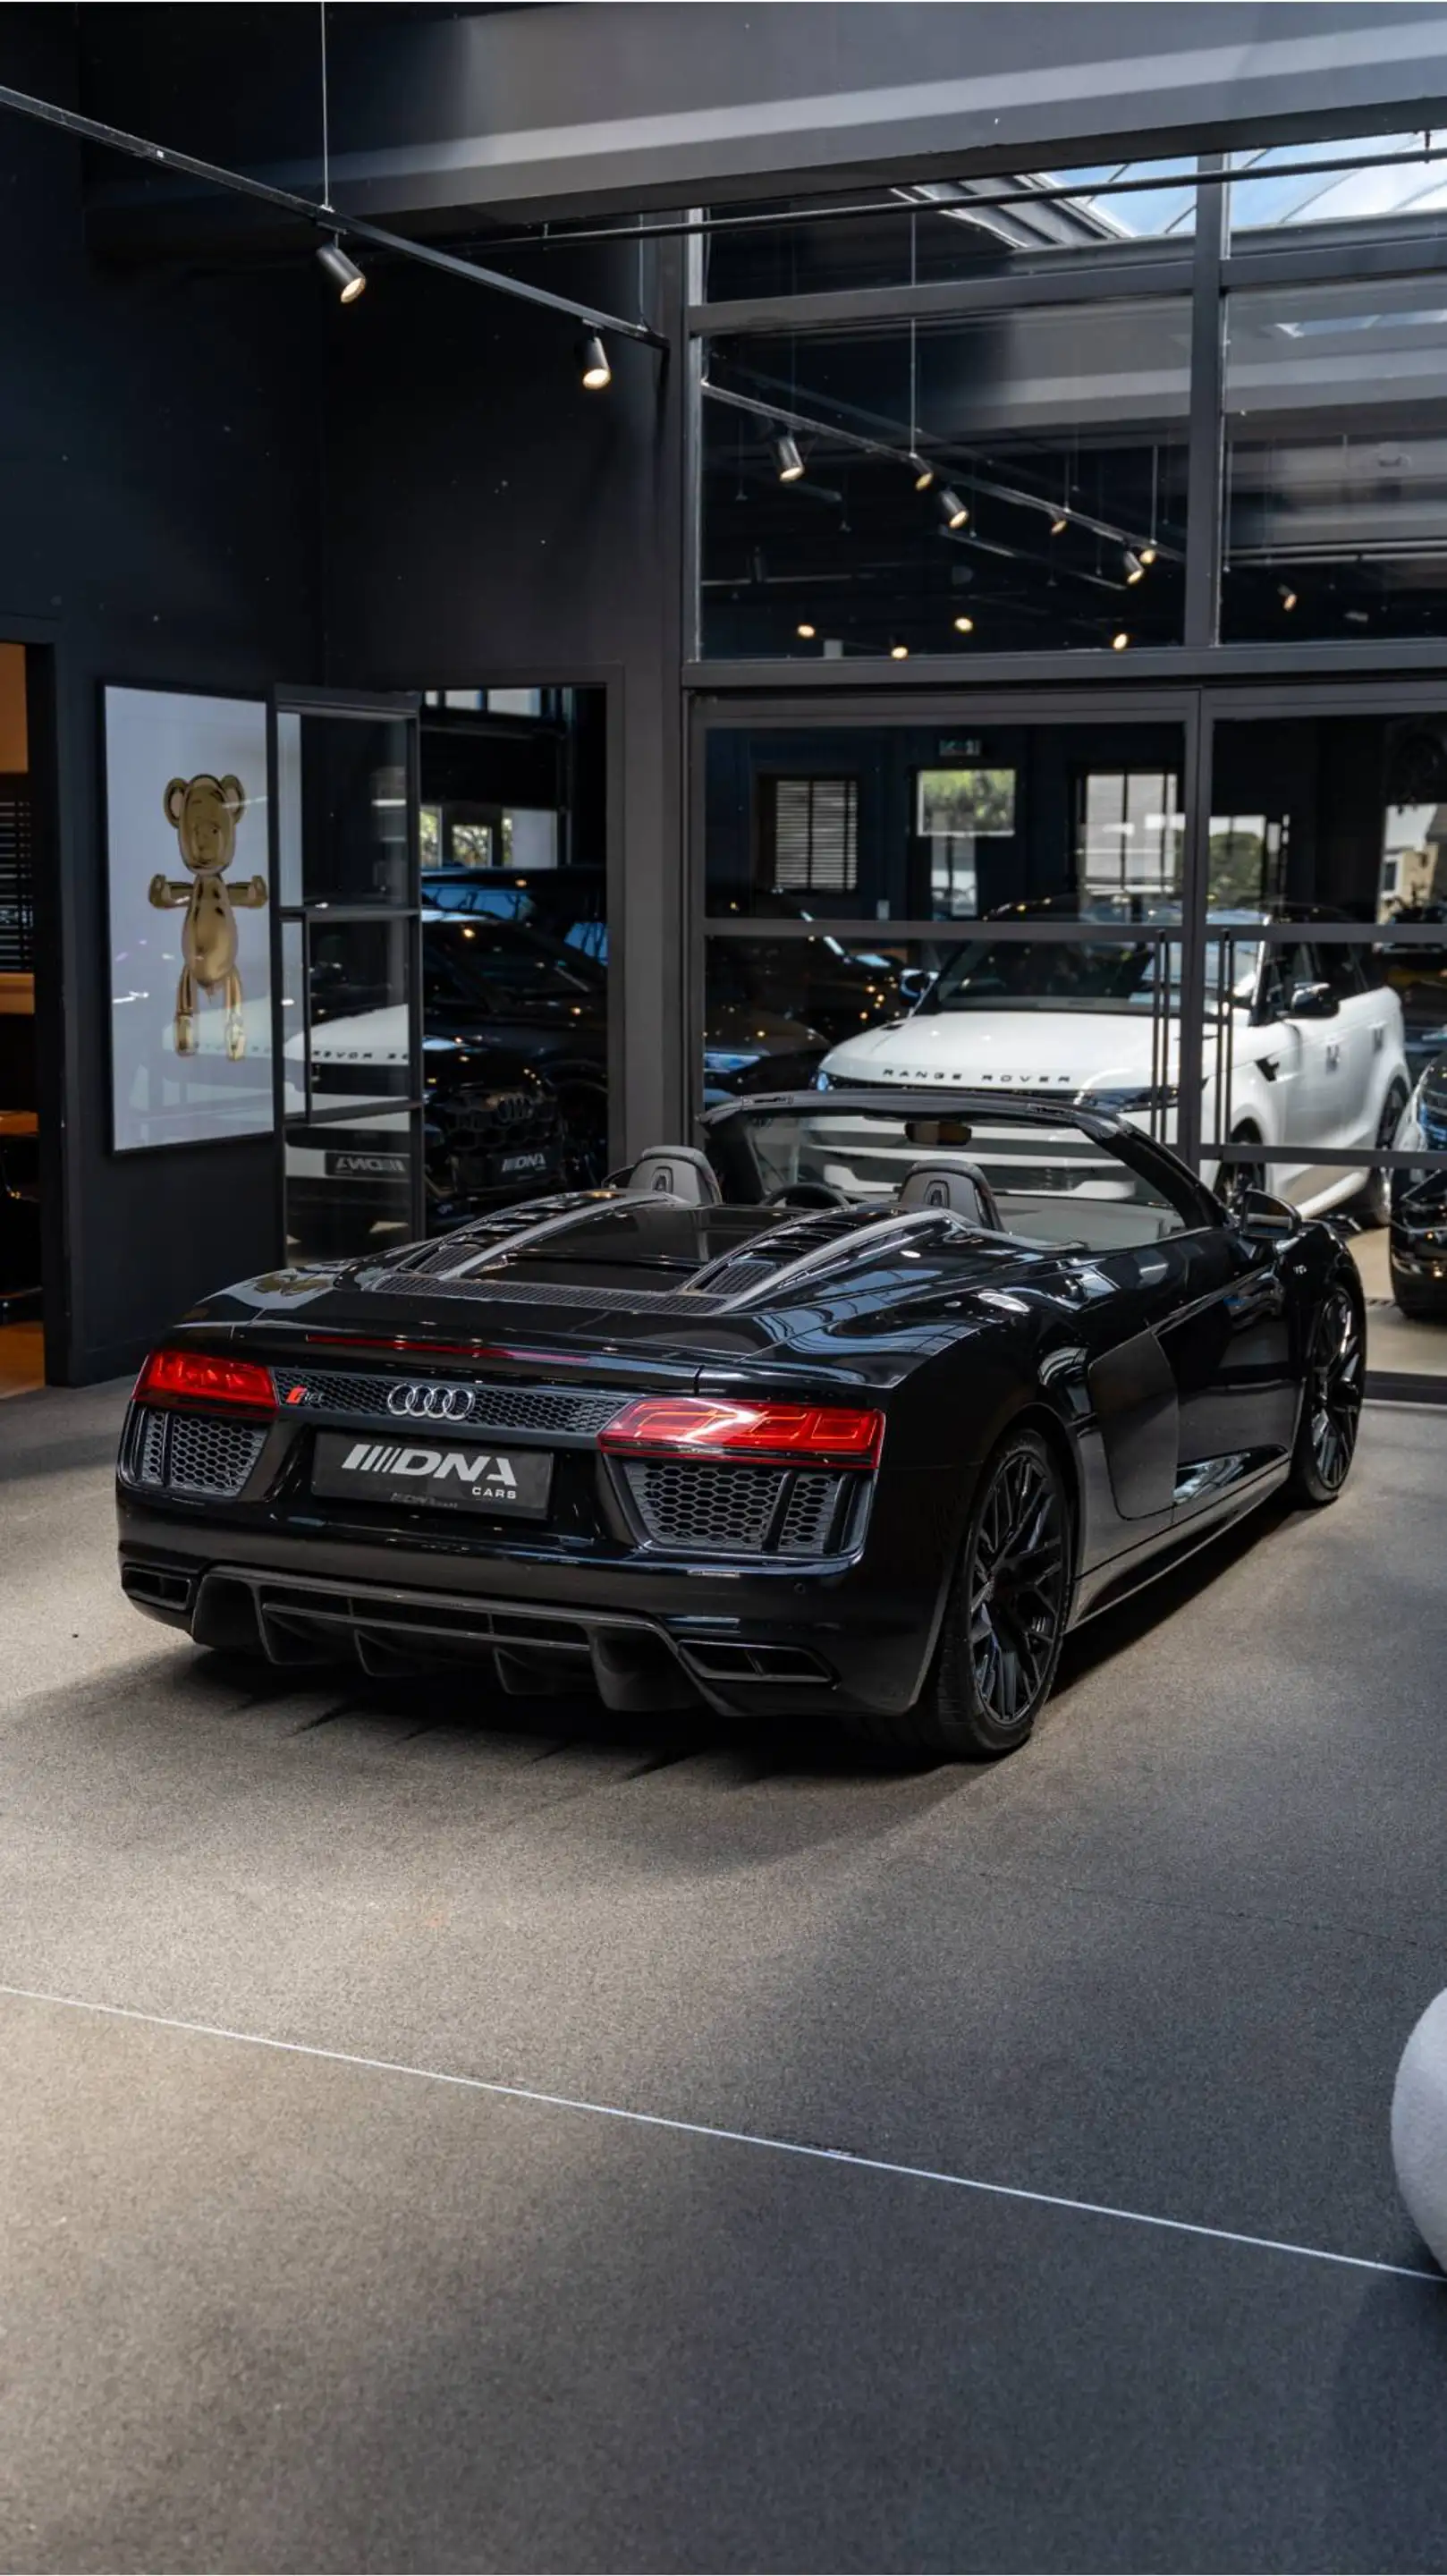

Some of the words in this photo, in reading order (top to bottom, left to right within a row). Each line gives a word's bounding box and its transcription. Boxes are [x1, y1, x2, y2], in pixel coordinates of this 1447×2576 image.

[883, 1069, 962, 1080] RANGE
[982, 1073, 1070, 1083] ROVER
[389, 1447, 518, 1487] DNA
[471, 1486, 517, 1500] CARS
